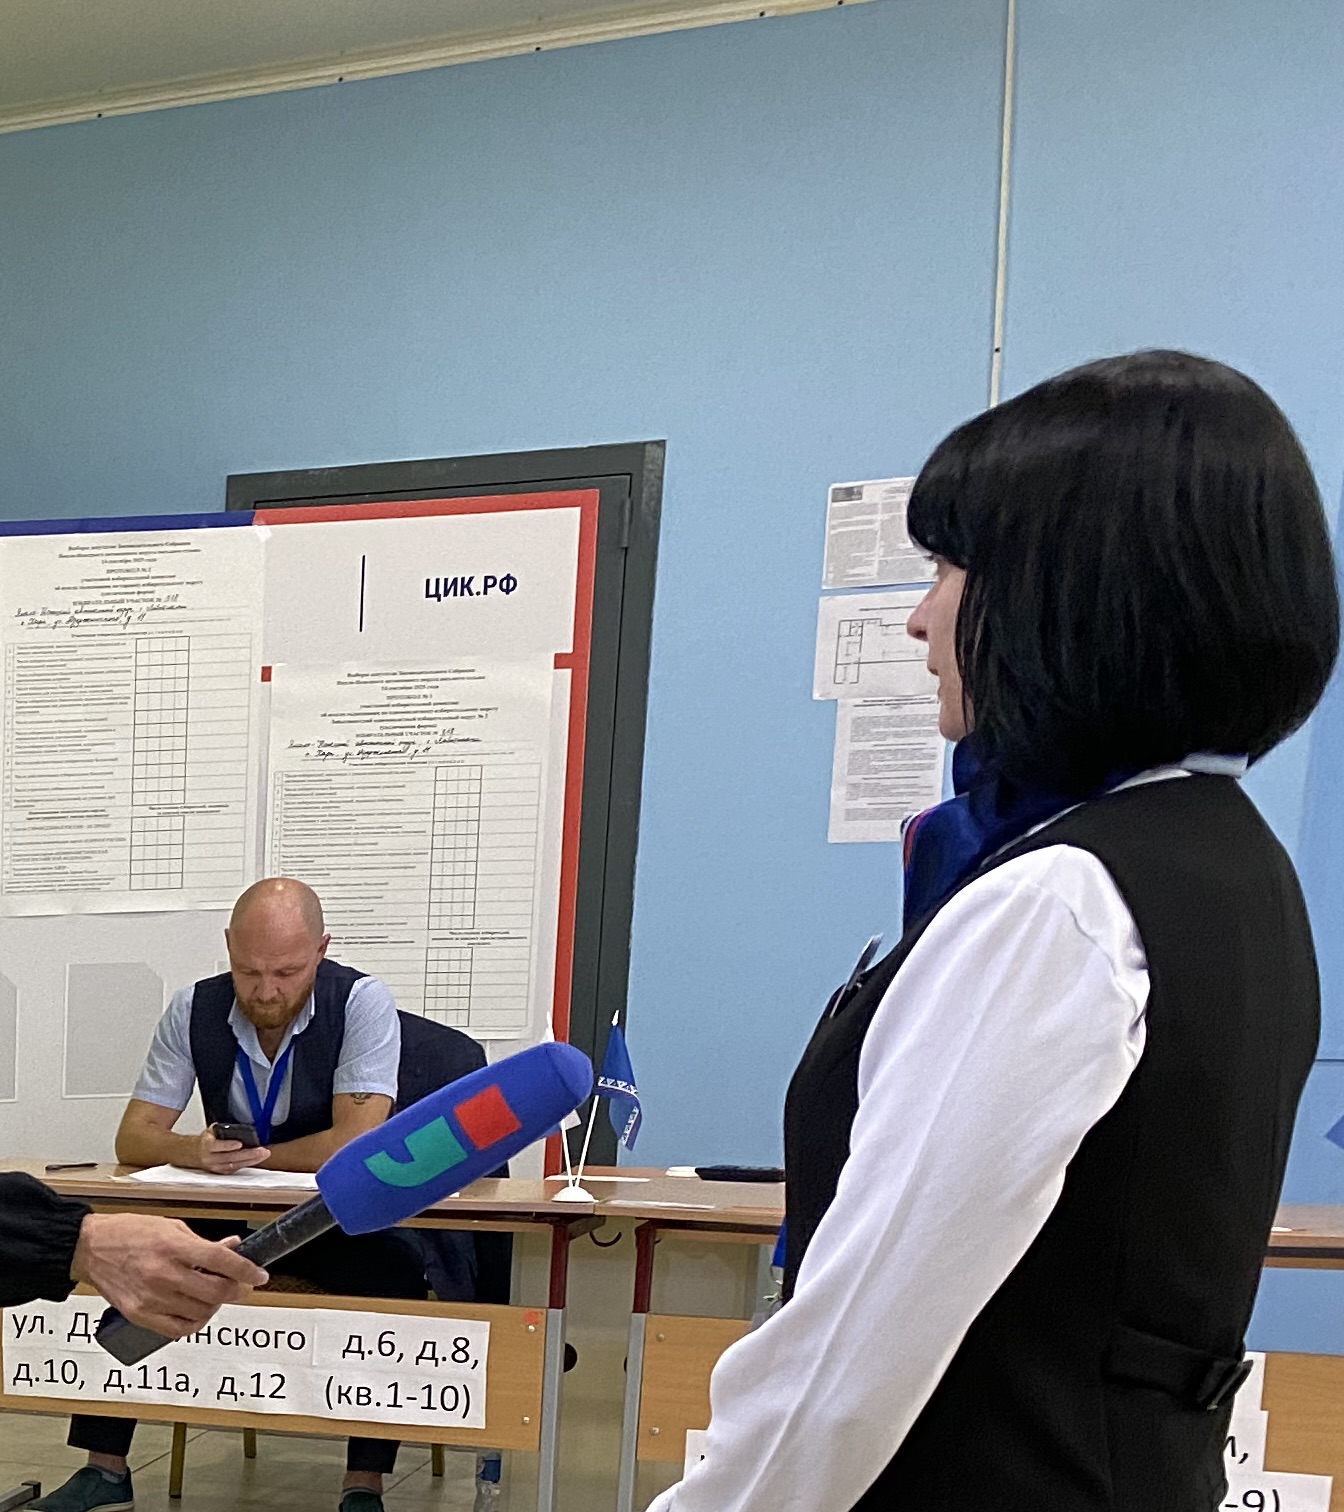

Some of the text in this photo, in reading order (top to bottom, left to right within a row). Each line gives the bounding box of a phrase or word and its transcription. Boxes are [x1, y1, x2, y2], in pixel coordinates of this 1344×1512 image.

[425, 573, 518, 602] ЦИК.РФ
[12, 1312, 479, 1370] ул. Дзнского д.6, д.8,
[13, 1358, 471, 1419] д.10, д.11а, д.12 (кв.1-10)
